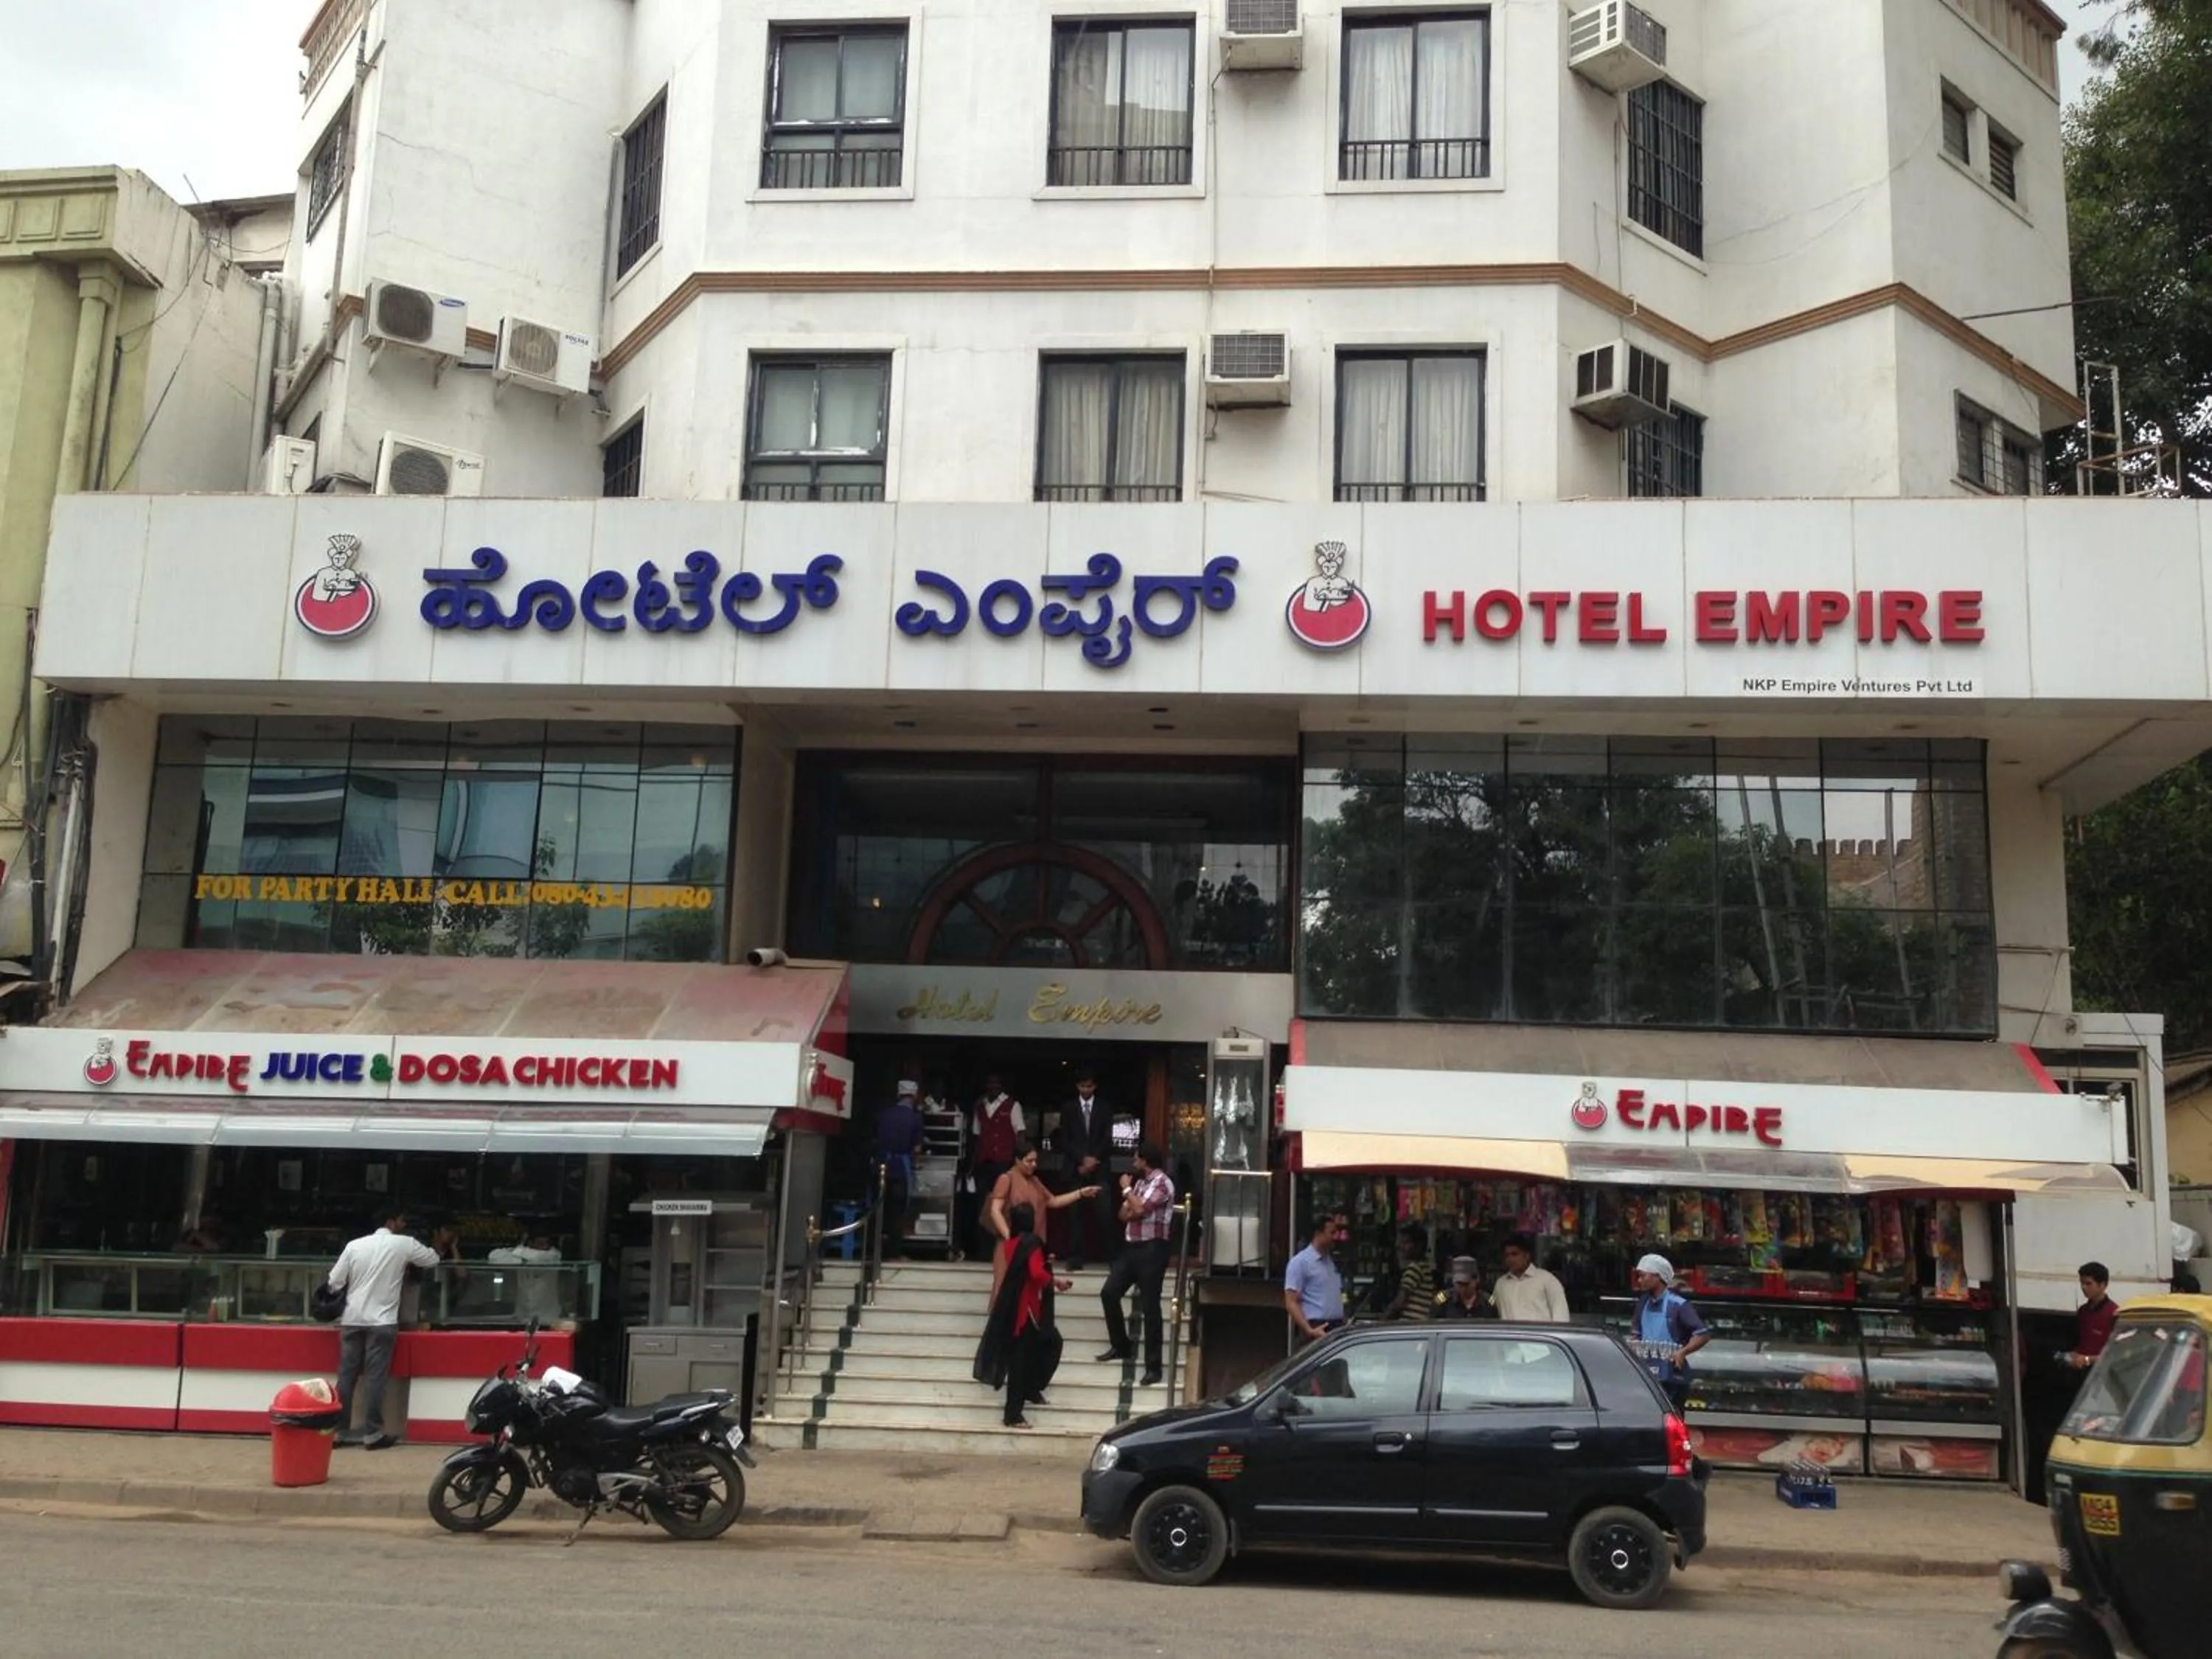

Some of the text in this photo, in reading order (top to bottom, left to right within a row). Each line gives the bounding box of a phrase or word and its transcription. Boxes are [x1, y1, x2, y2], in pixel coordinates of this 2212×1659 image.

[1423, 589, 1985, 644] HOTEL EMPIRE
[1743, 678, 1972, 694] NKP Empire Ventures Pvt Ltd
[195, 874, 252, 900] FOR
[258, 875, 350, 903] PARTY
[354, 877, 434, 904] HALL
[1029, 982, 1163, 1034] Empire
[260, 1052, 366, 1082] JUICE
[368, 1053, 392, 1082] &
[399, 1054, 509, 1085] DOSA
[513, 1056, 679, 1088] CHICKEN
